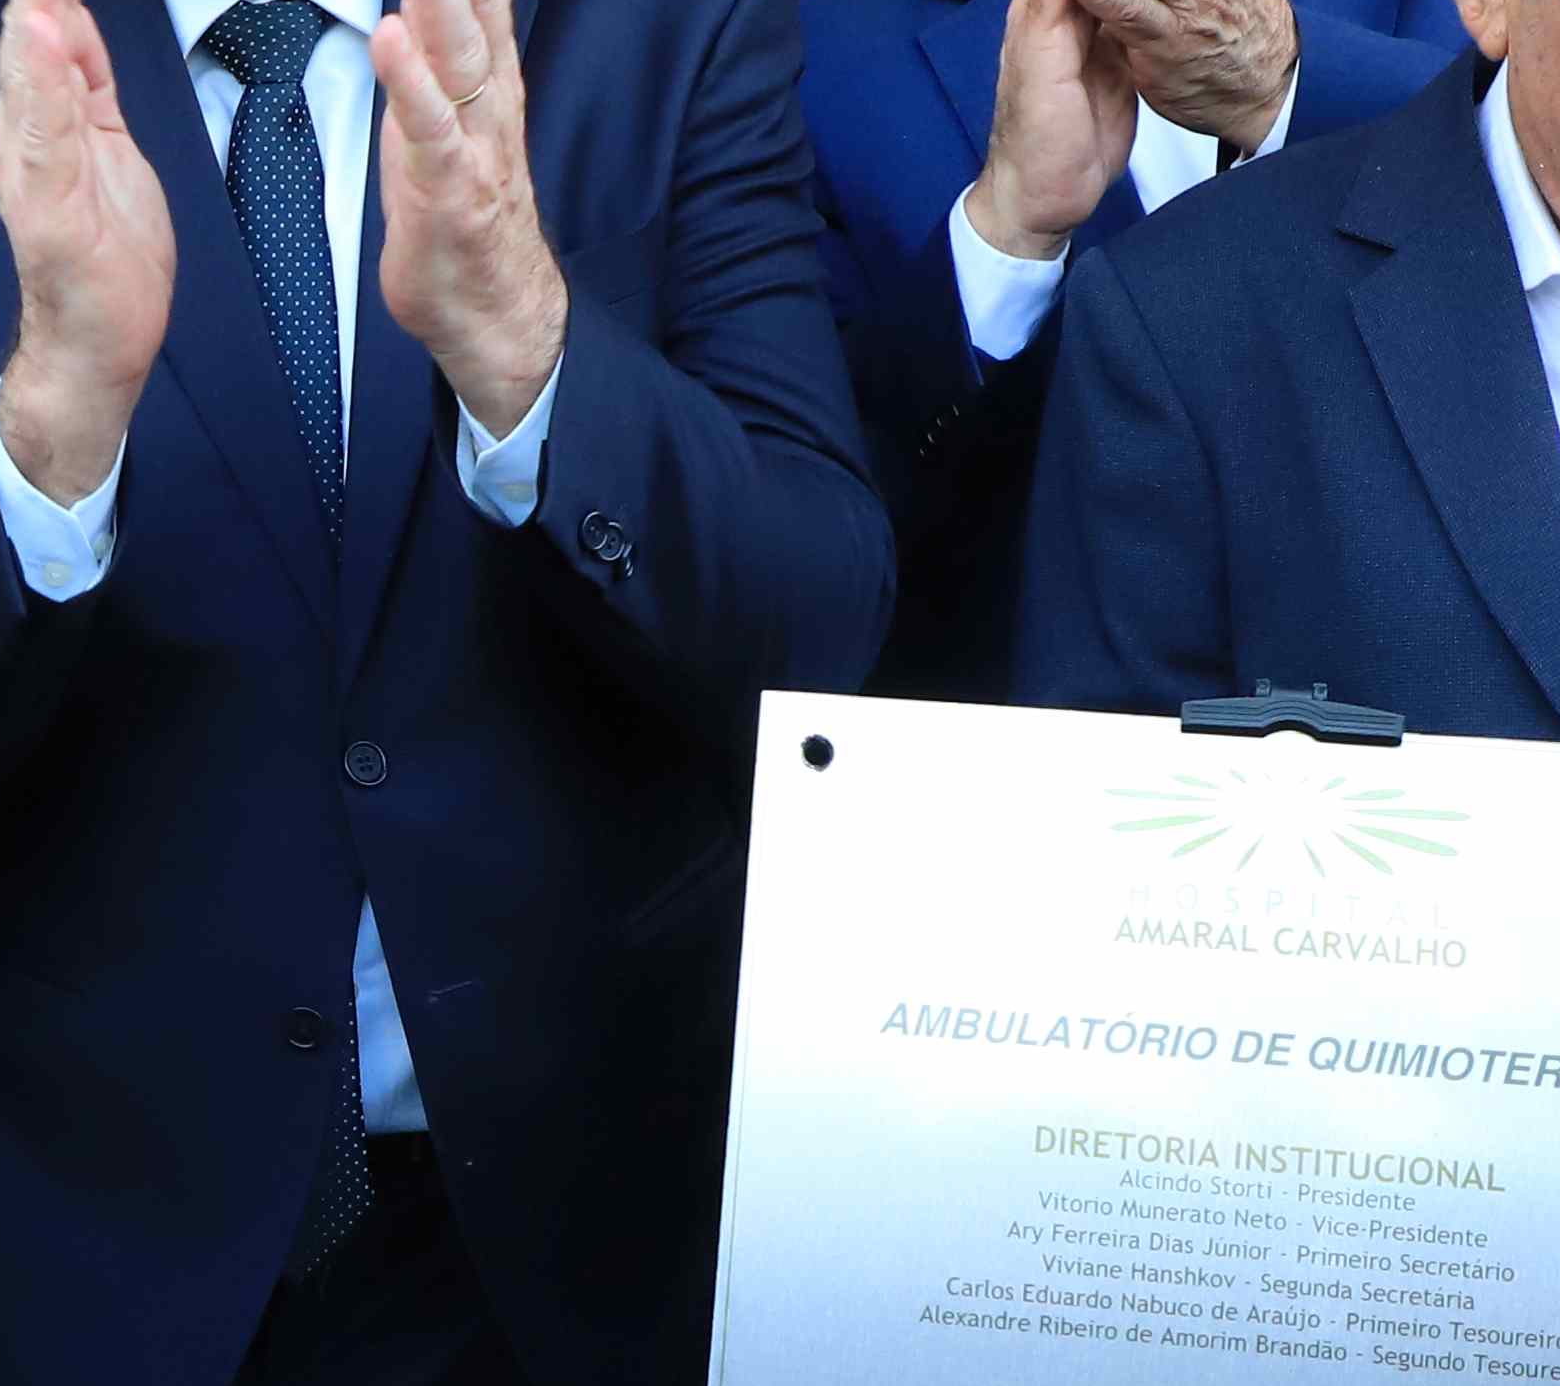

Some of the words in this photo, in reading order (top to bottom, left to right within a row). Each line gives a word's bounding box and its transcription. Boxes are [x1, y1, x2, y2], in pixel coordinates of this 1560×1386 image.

[1113, 915, 1259, 954] AMARAL
[1271, 925, 1468, 969] CARVALHO
[881, 1001, 1218, 1062] AMBULATÓRIO
[1230, 1028, 1297, 1068] DE
[1034, 1124, 1221, 1170] DIRETORIA
[1233, 1140, 1507, 1193] INSTITUCIONAL
[1006, 1219, 1046, 1246] Ary
[1050, 1221, 1142, 1251] Ferreira
[1147, 1229, 1195, 1256] Dias
[1200, 1235, 1274, 1262] Júnior
[1295, 1243, 1393, 1273] Primeiro
[1398, 1252, 1516, 1284] Secretário
[918, 1303, 1032, 1334] Alexandre
[1038, 1313, 1119, 1342] Ribeiro
[1124, 1321, 1154, 1345] de
[1159, 1324, 1248, 1353] Amorim
[1254, 1333, 1349, 1362] Brandão
[1371, 1343, 1467, 1373] Segundo
[945, 1275, 1015, 1303] Carlos
[1021, 1282, 1114, 1311] Eduardo
[1119, 1291, 1205, 1323] Nabuco
[1209, 1299, 1240, 1323] de
[1244, 1303, 1322, 1332] Araújo
[1345, 1311, 1443, 1341] Primeiro
